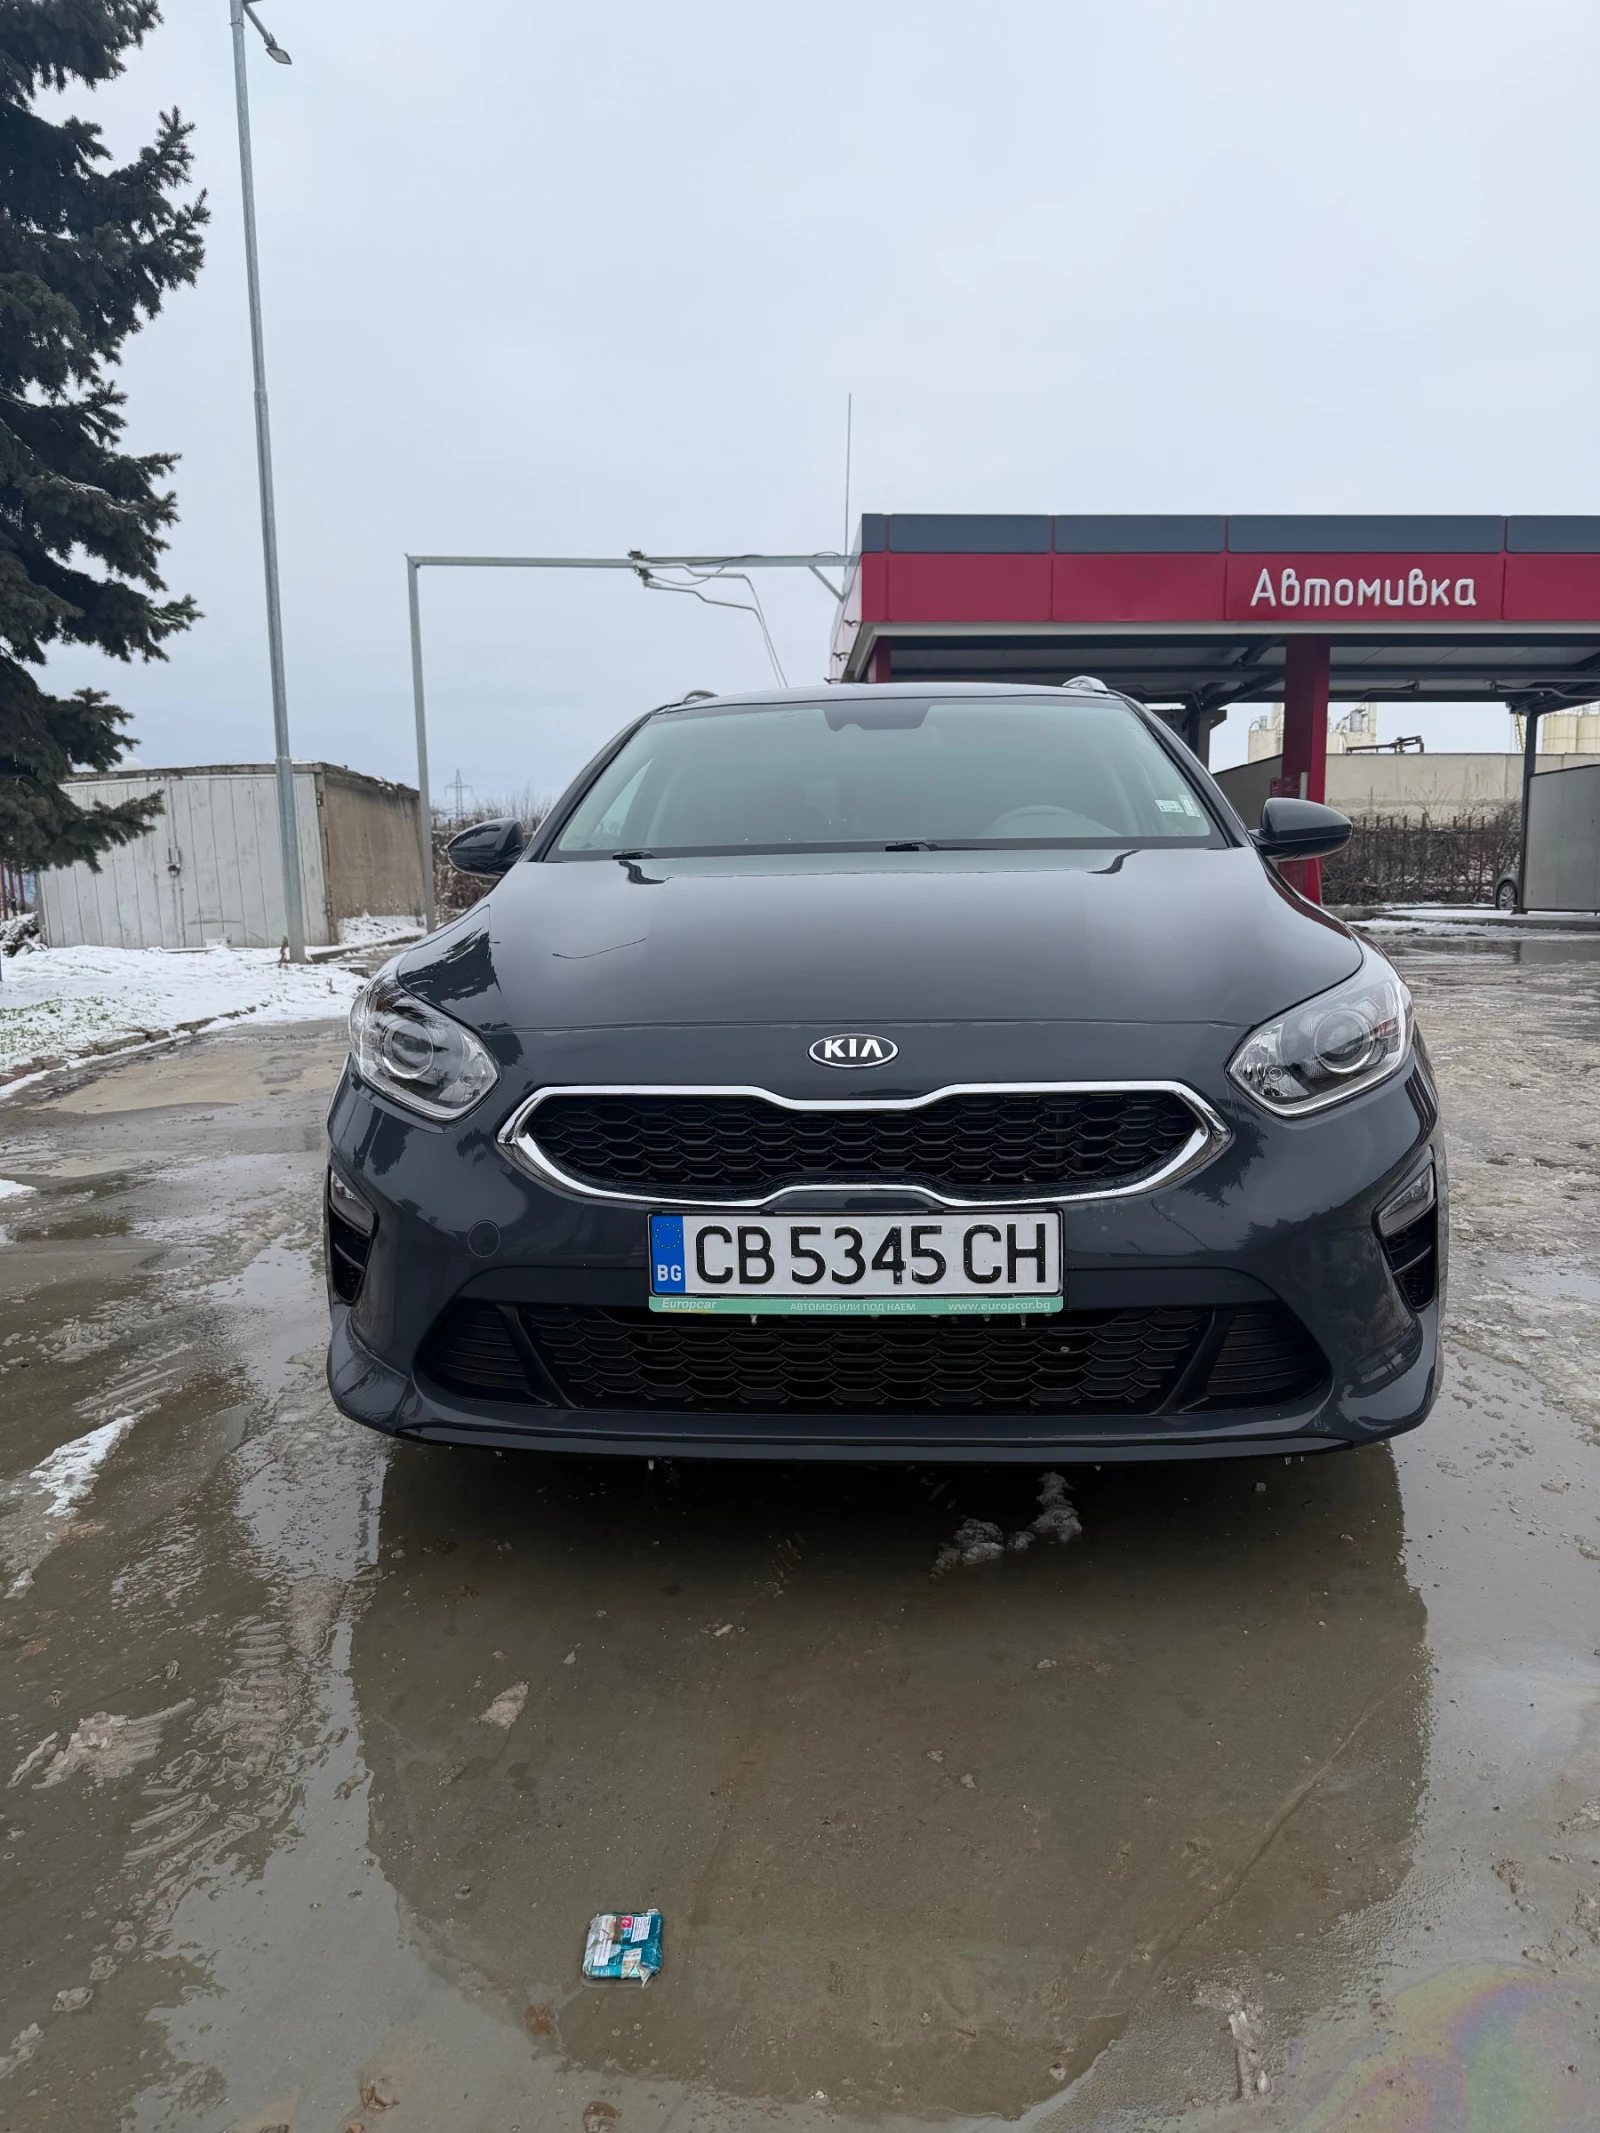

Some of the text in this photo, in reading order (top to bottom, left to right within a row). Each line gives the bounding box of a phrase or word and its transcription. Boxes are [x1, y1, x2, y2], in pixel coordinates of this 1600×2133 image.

[1250, 568, 1477, 607] Автомивка
[824, 1038, 884, 1058] KIA
[695, 1223, 1047, 1285] CB 5345 CH
[657, 1264, 682, 1282] BG
[661, 1297, 717, 1313] Europcar
[790, 1302, 916, 1313] АВТОМОБИЛИ ПОД НАЕМ
[948, 1300, 1051, 1312] www.europcar.bg
